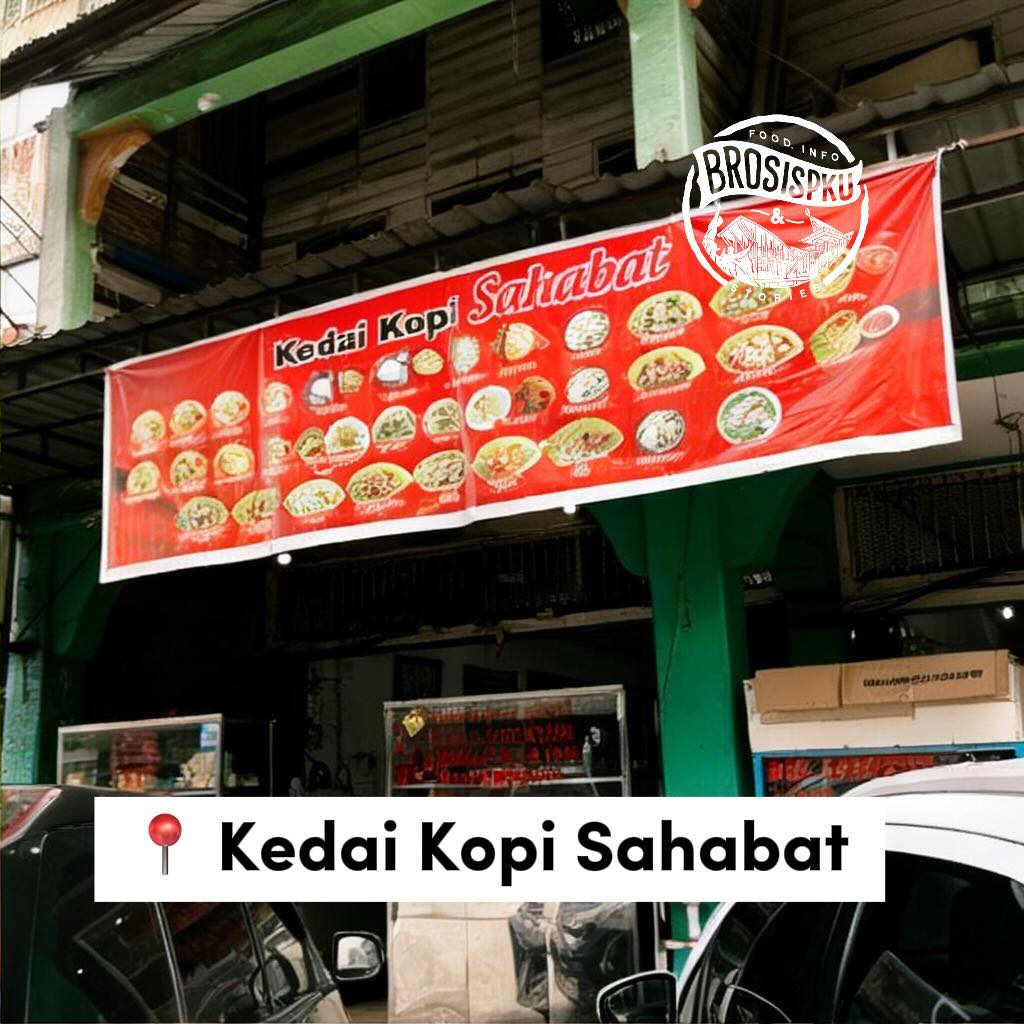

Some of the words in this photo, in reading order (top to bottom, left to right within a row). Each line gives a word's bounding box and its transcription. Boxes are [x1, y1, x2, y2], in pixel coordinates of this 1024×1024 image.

[273, 319, 369, 371] Kedai
[376, 296, 460, 343] Kopi
[467, 235, 673, 326] Sahabat
